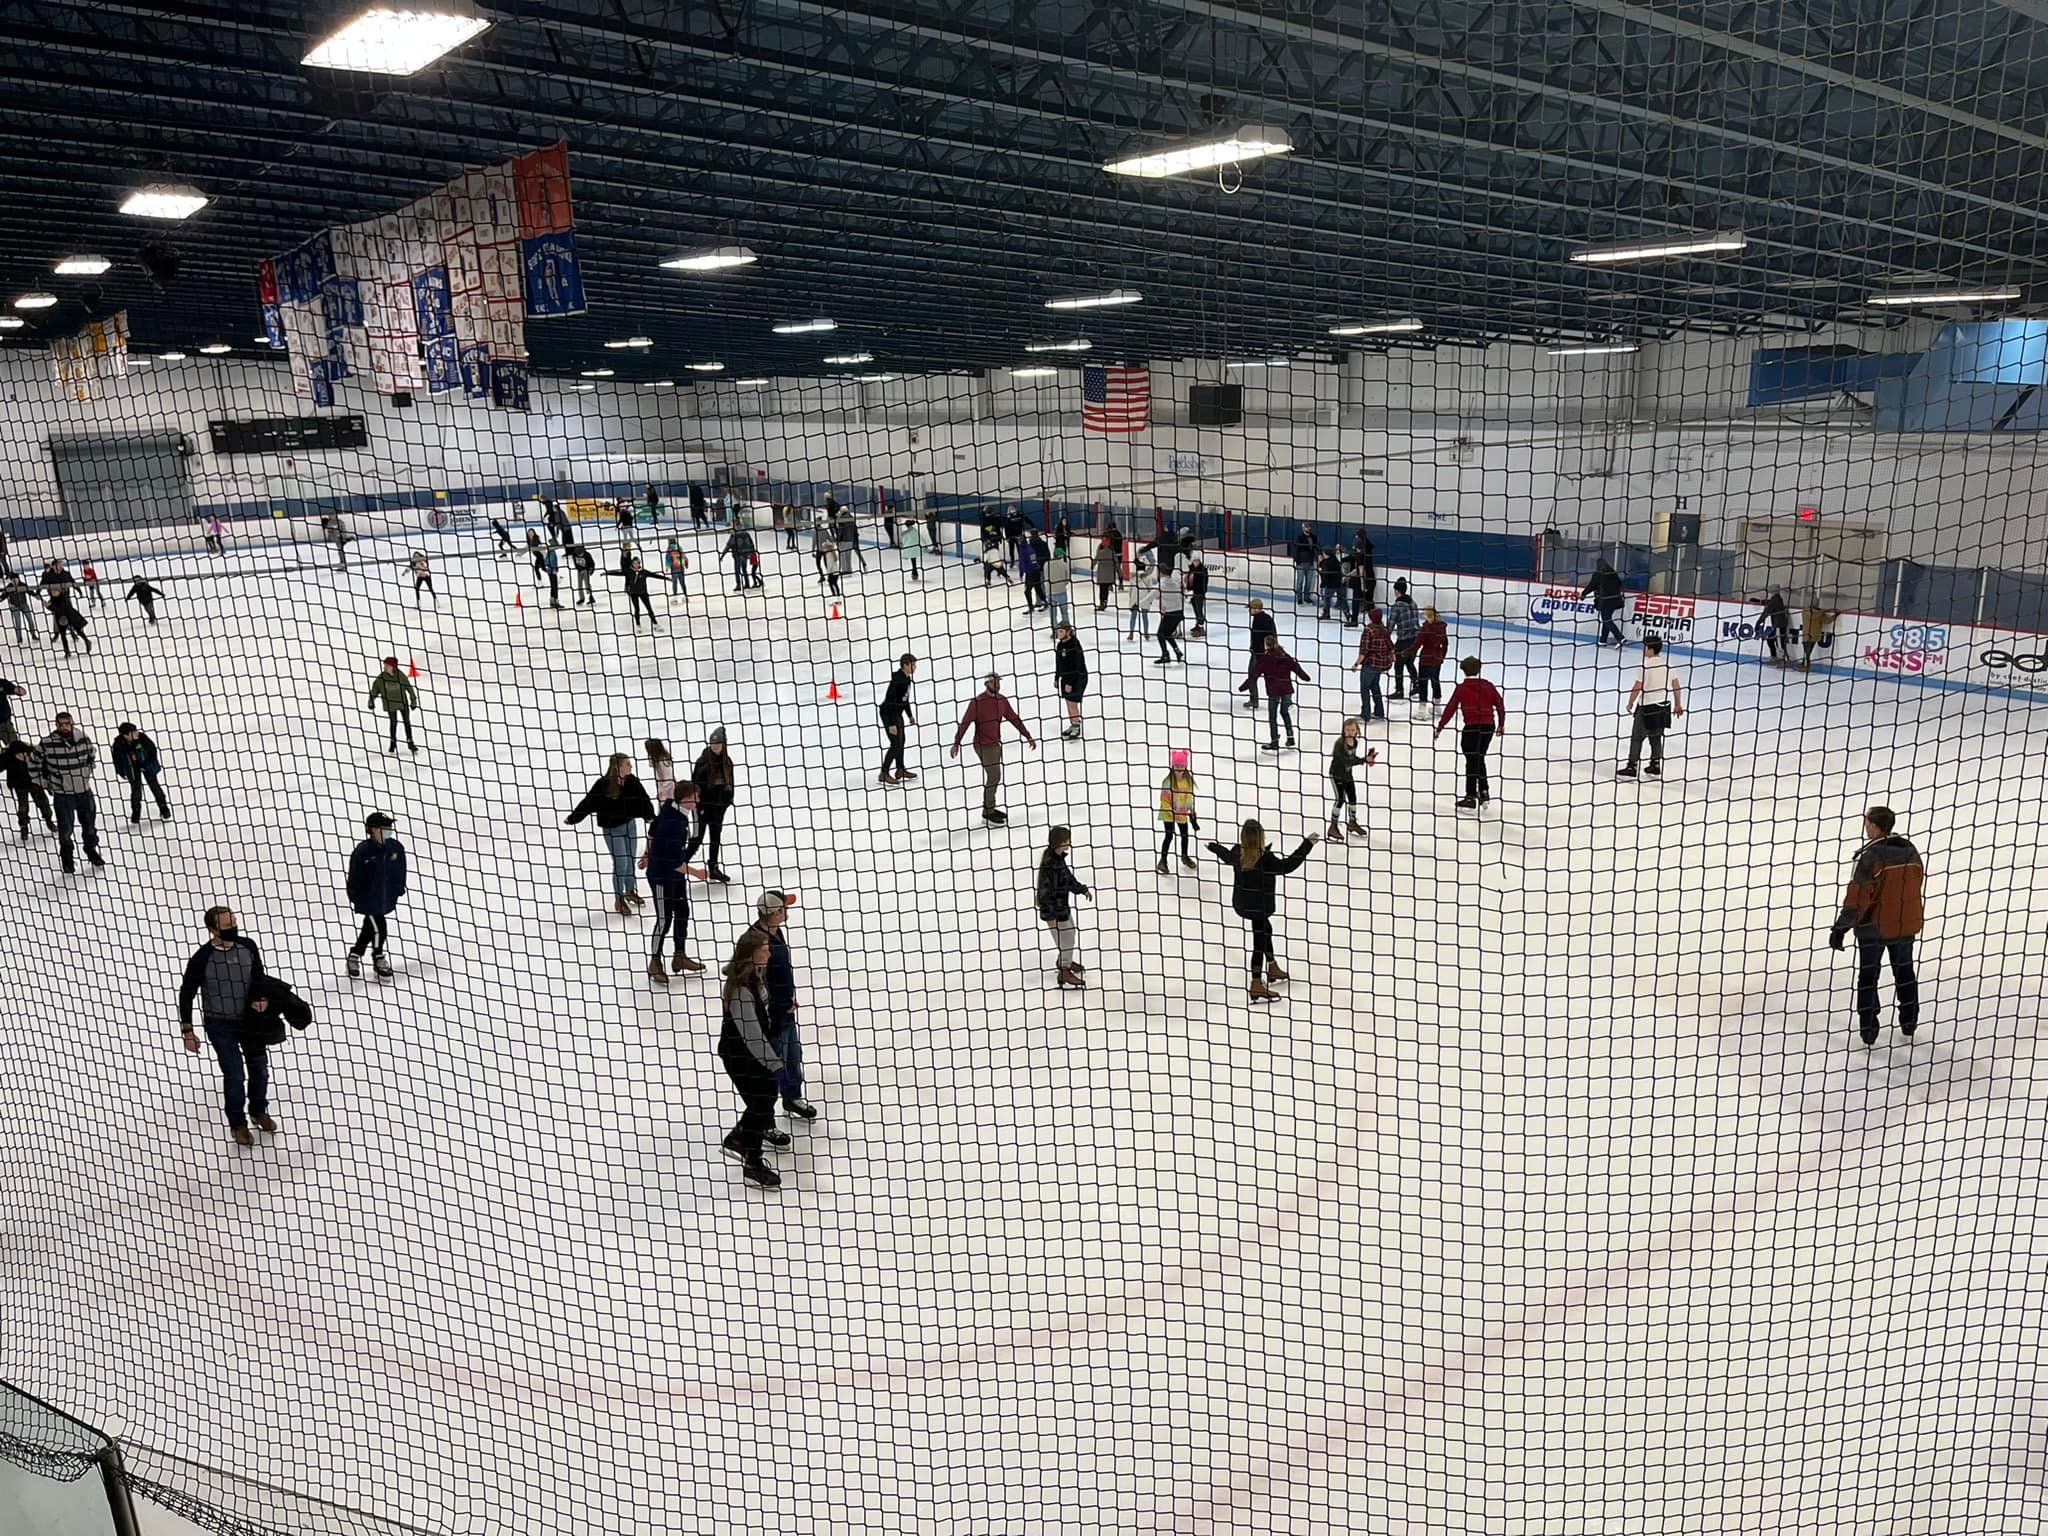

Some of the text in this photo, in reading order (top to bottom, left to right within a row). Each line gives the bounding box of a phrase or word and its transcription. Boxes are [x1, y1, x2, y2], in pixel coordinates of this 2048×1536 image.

[1541, 598, 1596, 615] ROOTER
[1634, 594, 1694, 617] ESPN
[1631, 612, 1692, 631] PEORIA
[1722, 620, 1833, 648] KOMTU
[1924, 653, 1944, 665] FM
